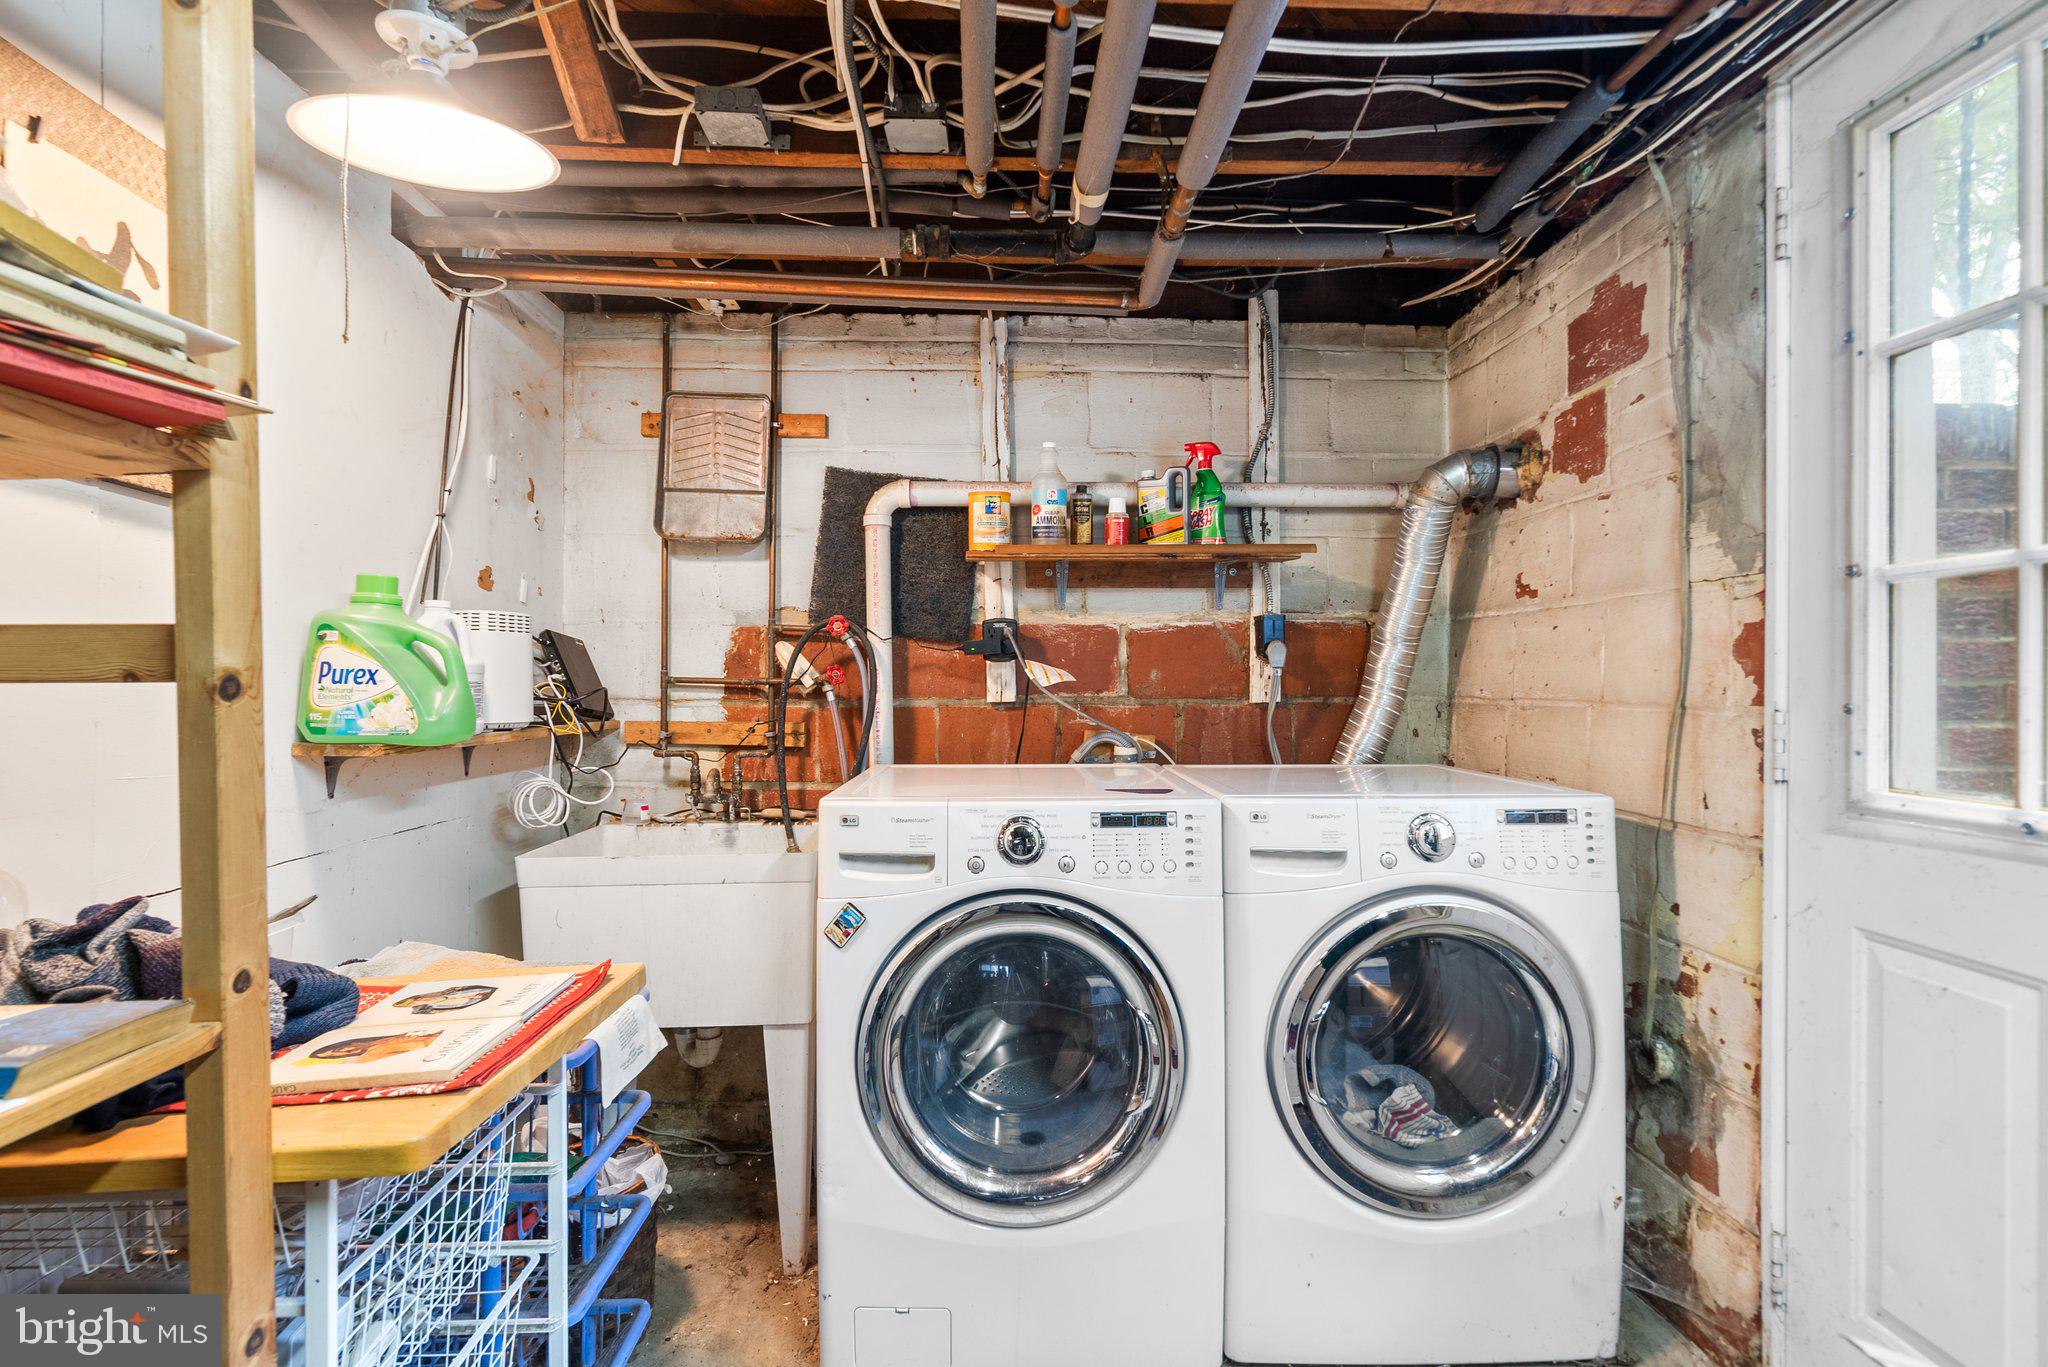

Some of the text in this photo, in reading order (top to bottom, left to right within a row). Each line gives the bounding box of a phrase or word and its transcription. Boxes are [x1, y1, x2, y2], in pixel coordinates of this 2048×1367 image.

[1140, 503, 1149, 514] C
[1035, 515, 1067, 526] AMMONIA
[1143, 516, 1151, 525] L
[1145, 526, 1154, 537] R
[317, 661, 379, 686] Purex
[325, 686, 354, 694] Natural
